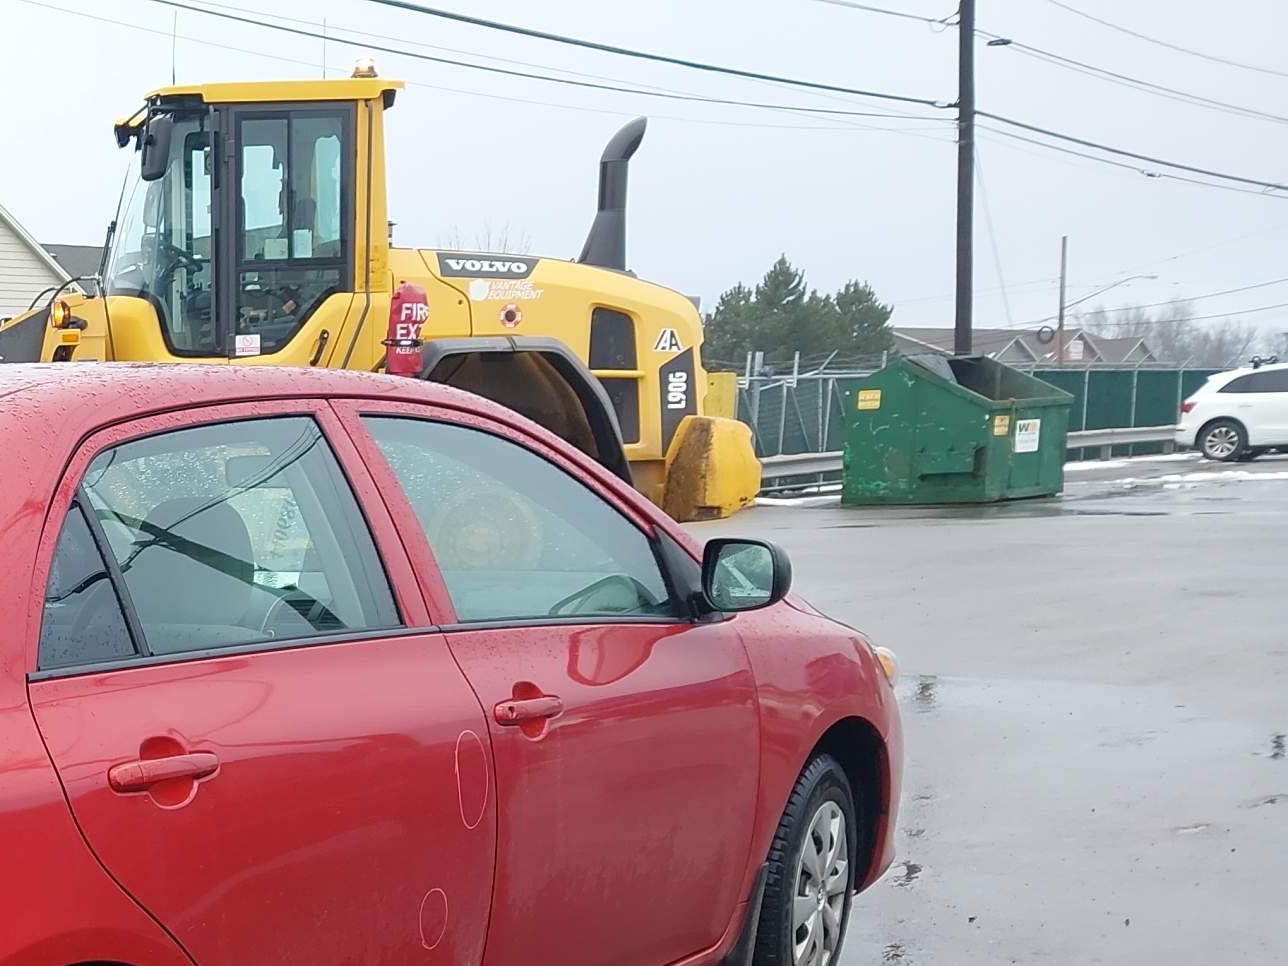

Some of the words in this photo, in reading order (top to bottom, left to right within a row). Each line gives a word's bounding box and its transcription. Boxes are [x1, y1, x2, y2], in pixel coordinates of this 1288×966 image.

[445, 259, 528, 273] VOLVO
[488, 289, 544, 300] EQUIPMENT
[666, 371, 688, 410] L90G
